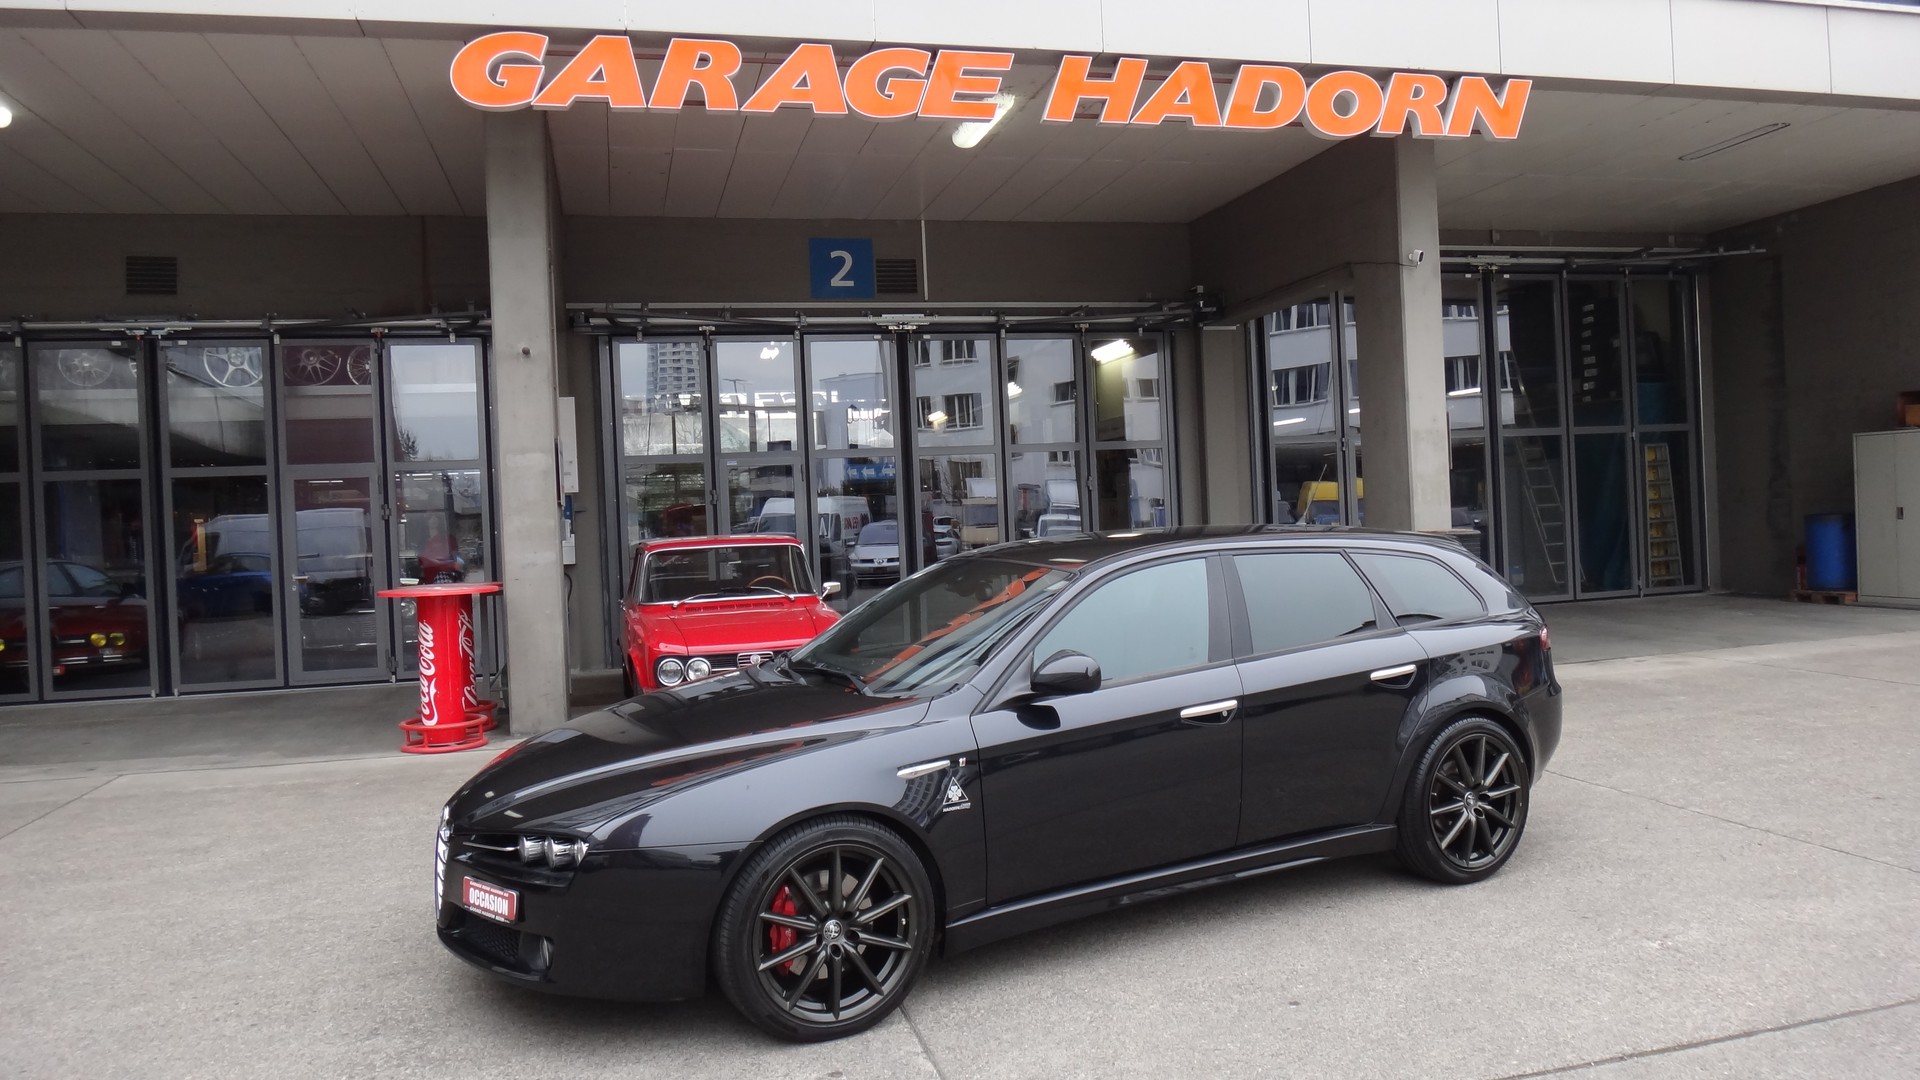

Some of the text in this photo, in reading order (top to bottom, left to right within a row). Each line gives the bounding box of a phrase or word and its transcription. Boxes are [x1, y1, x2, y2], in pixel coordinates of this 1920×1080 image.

[450, 31, 1533, 140] GARAGE HADORN
[830, 250, 854, 287] 2
[469, 887, 508, 916] OCCASION
